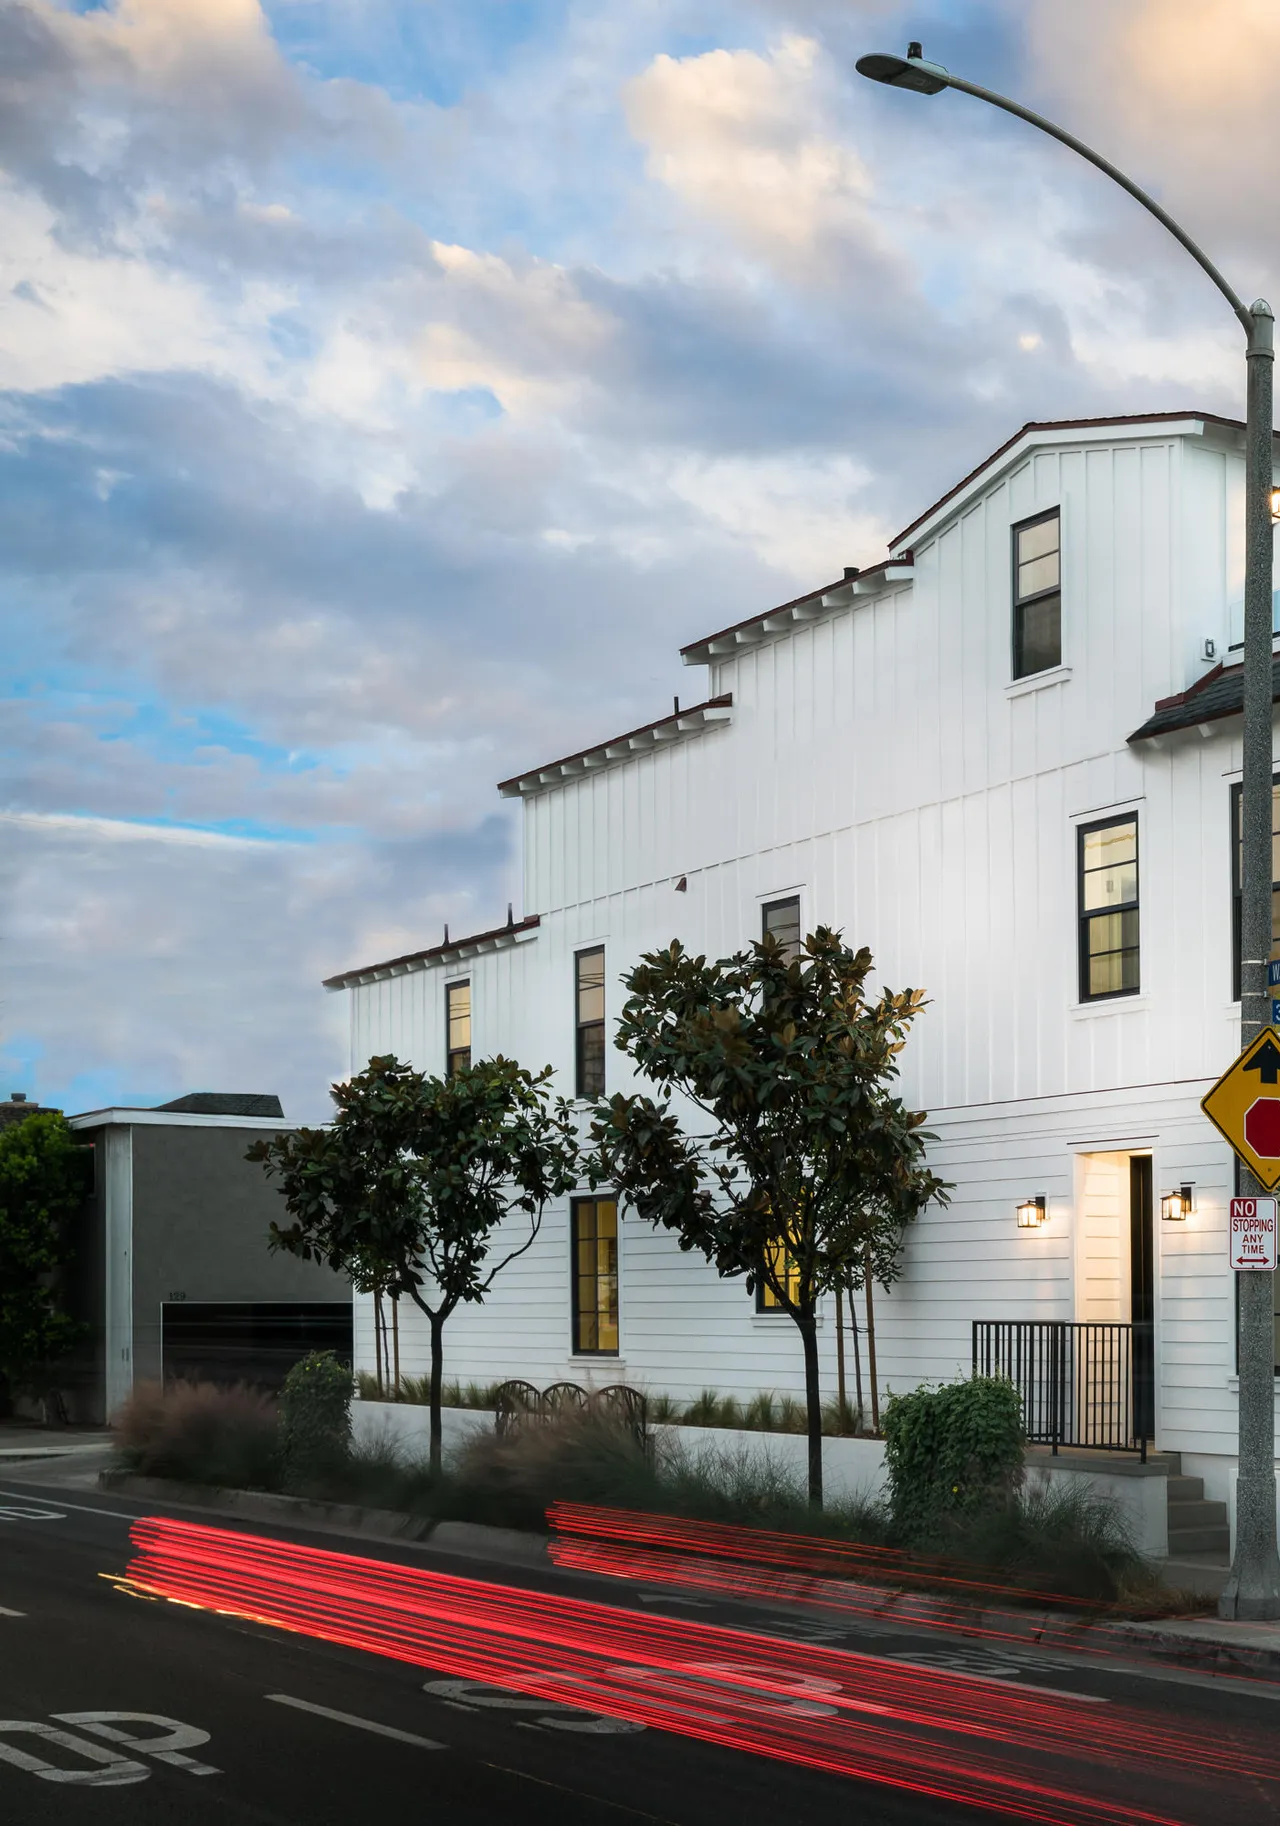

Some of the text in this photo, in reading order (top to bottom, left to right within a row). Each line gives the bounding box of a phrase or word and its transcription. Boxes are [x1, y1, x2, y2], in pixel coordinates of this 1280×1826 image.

[1234, 1201, 1255, 1216] NO
[1233, 1218, 1274, 1233] STOPPING
[1242, 1234, 1264, 1244] ANY
[1242, 1244, 1265, 1254] TIME
